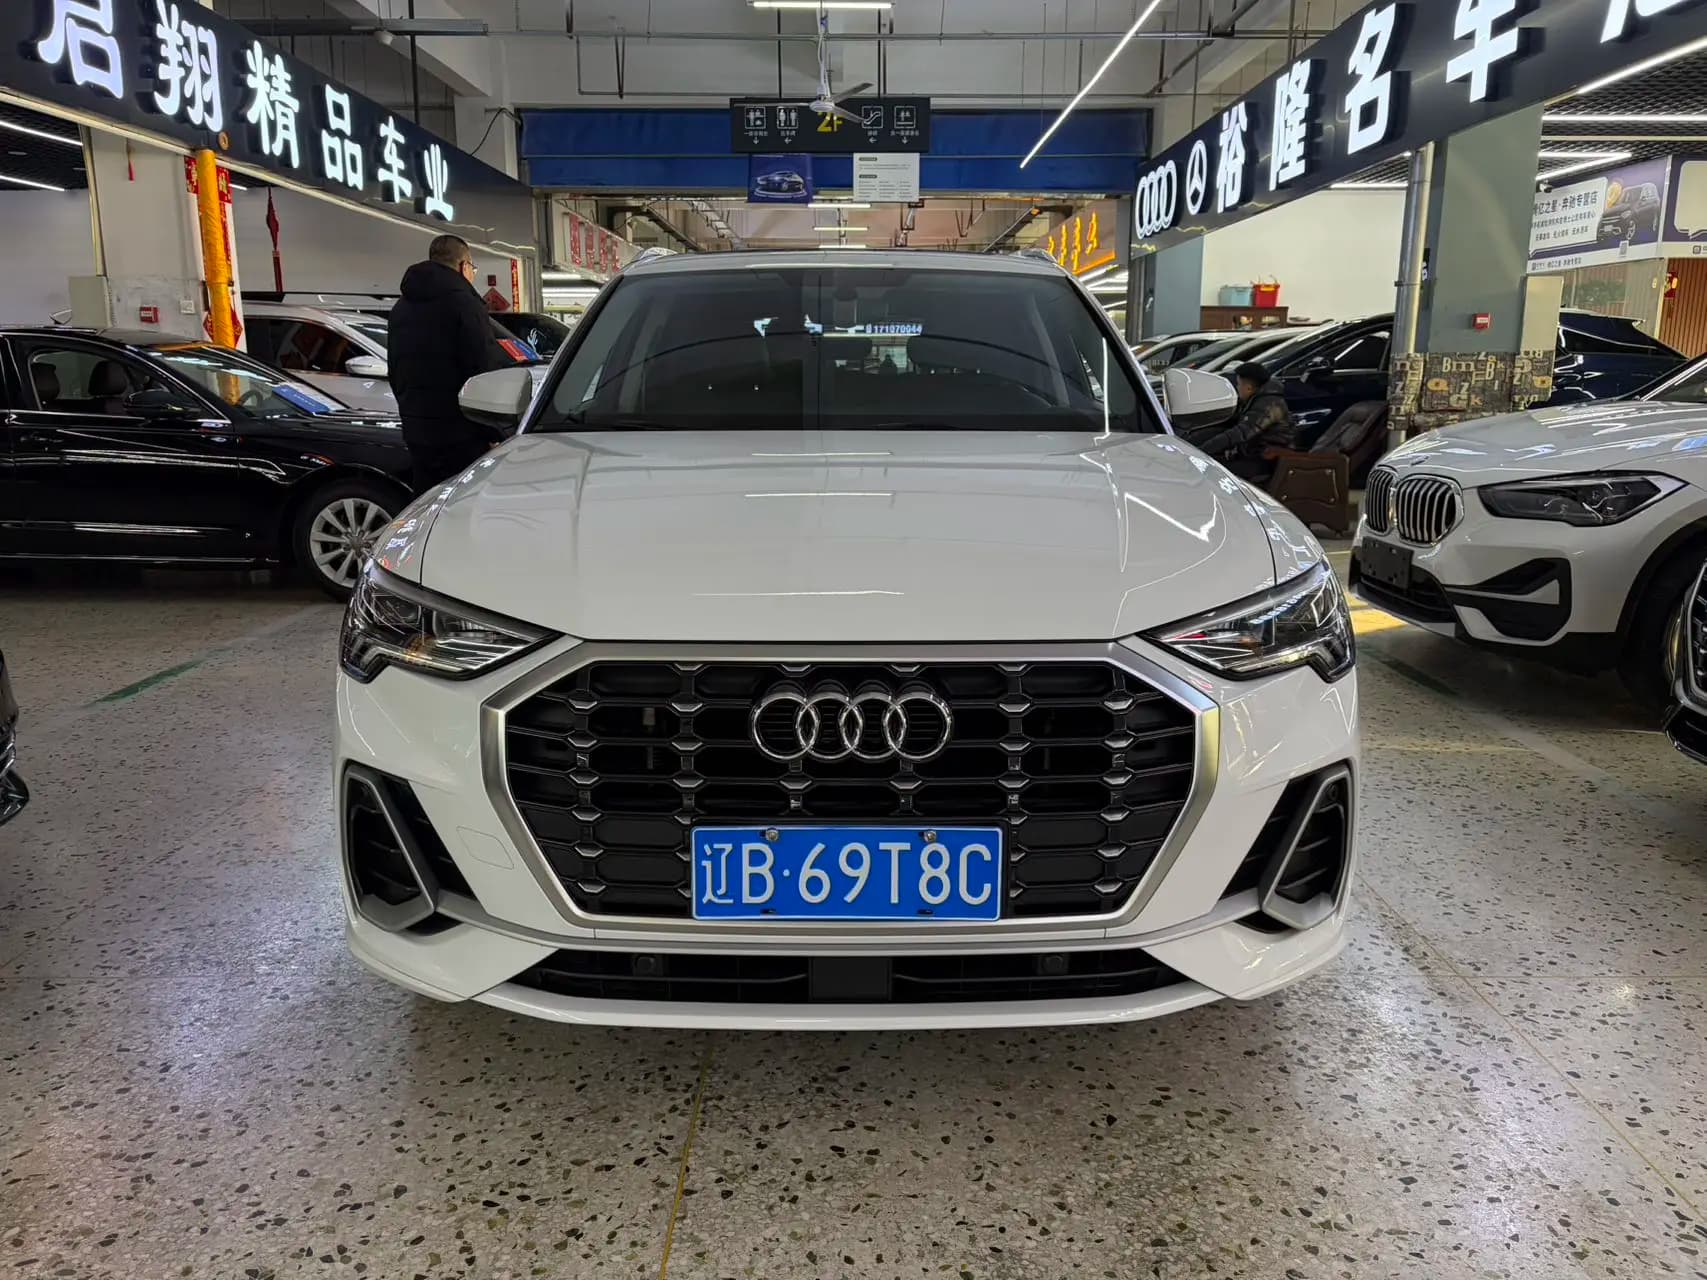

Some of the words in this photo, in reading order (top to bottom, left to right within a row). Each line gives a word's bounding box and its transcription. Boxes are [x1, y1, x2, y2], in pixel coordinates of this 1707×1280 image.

[1216, 0, 1690, 214] 裕隆名车
[701, 842, 992, 905] 辽B·69T8C
